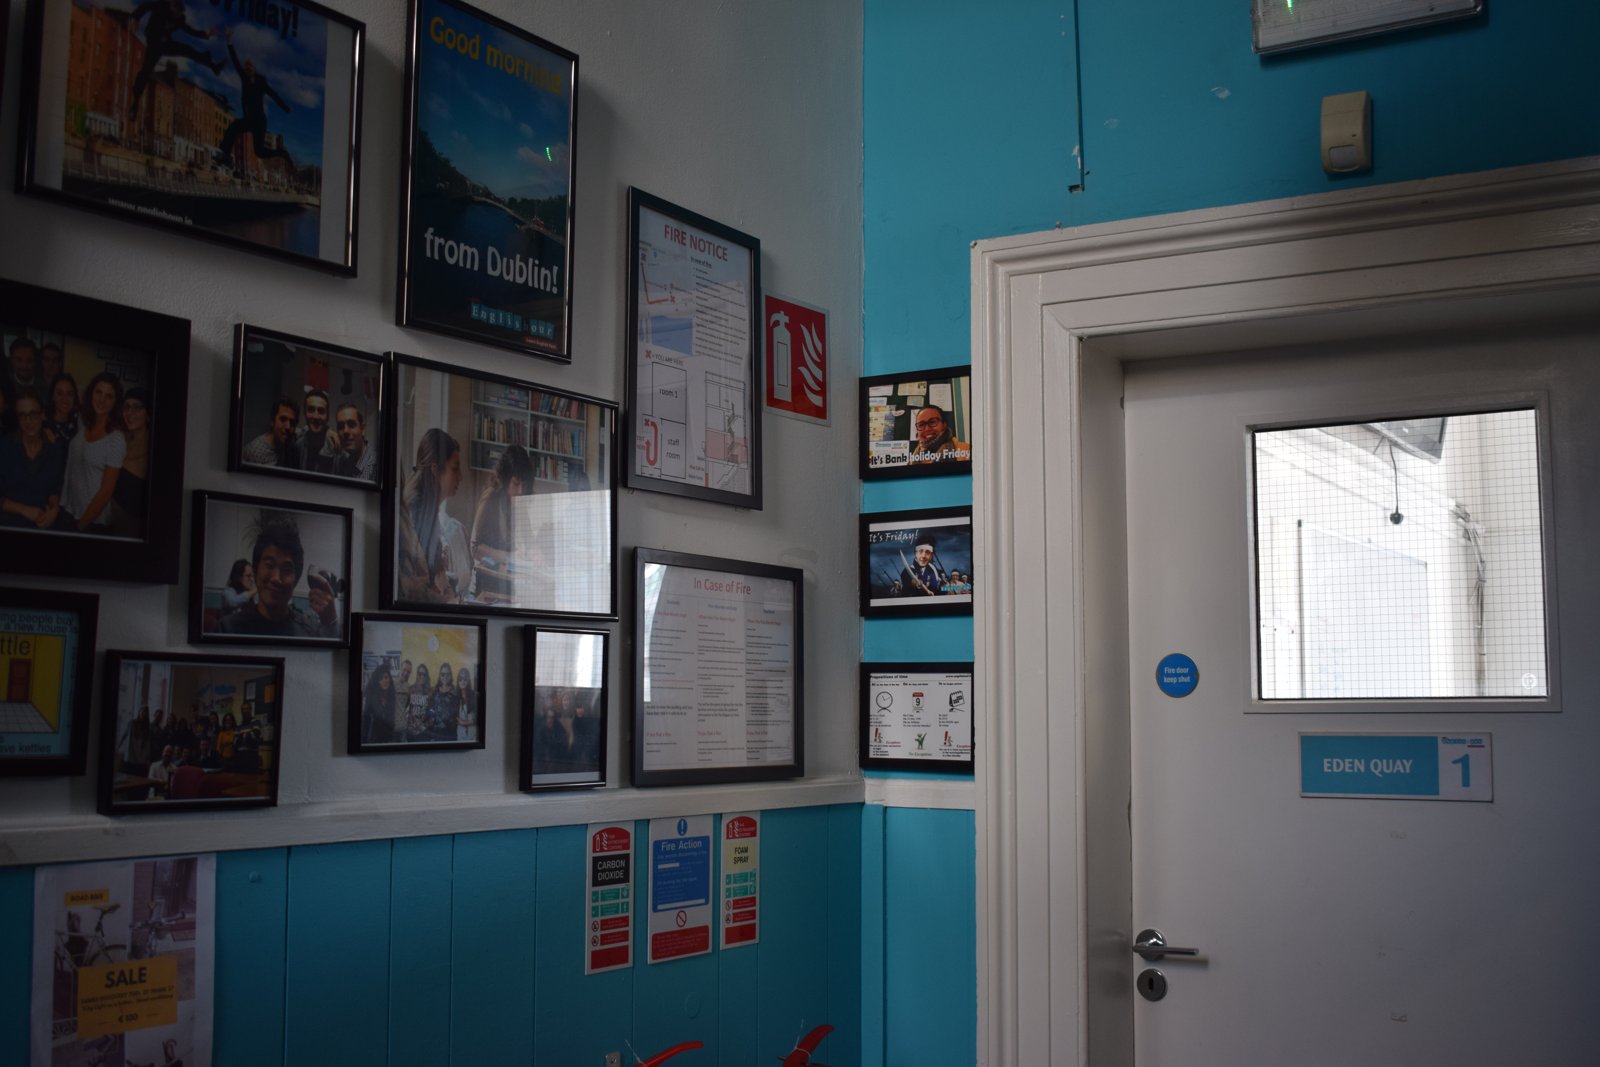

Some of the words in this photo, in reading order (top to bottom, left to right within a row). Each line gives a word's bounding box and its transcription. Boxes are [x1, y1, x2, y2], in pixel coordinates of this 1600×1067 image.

[430, 15, 480, 60] Good
[664, 224, 687, 246] FIRE
[689, 234, 728, 262] NOTICE
[424, 227, 480, 272] from
[487, 245, 559, 294] Dublin!
[659, 388, 674, 397] room
[667, 438, 680, 446] staff
[666, 451, 681, 460] room
[871, 455, 883, 465] It's
[885, 453, 908, 464] Bank
[909, 450, 941, 463] holiday
[942, 448, 971, 459] Friday
[868, 533, 883, 543] It's
[885, 529, 919, 544] Friday!
[693, 577, 702, 589] In
[703, 579, 723, 592] Case
[725, 580, 734, 592] of
[735, 582, 752, 595] Fire
[1323, 758, 1366, 774] EDEN
[1370, 758, 1413, 777] QUAY
[1451, 753, 1471, 788] 1
[661, 841, 676, 851] Fire
[678, 839, 703, 850] Action
[734, 846, 749, 854] FOAM
[597, 859, 626, 870] CARBON
[733, 855, 749, 865] SPRAY
[597, 870, 625, 881] DIOXIDE
[104, 966, 147, 989] SALE
